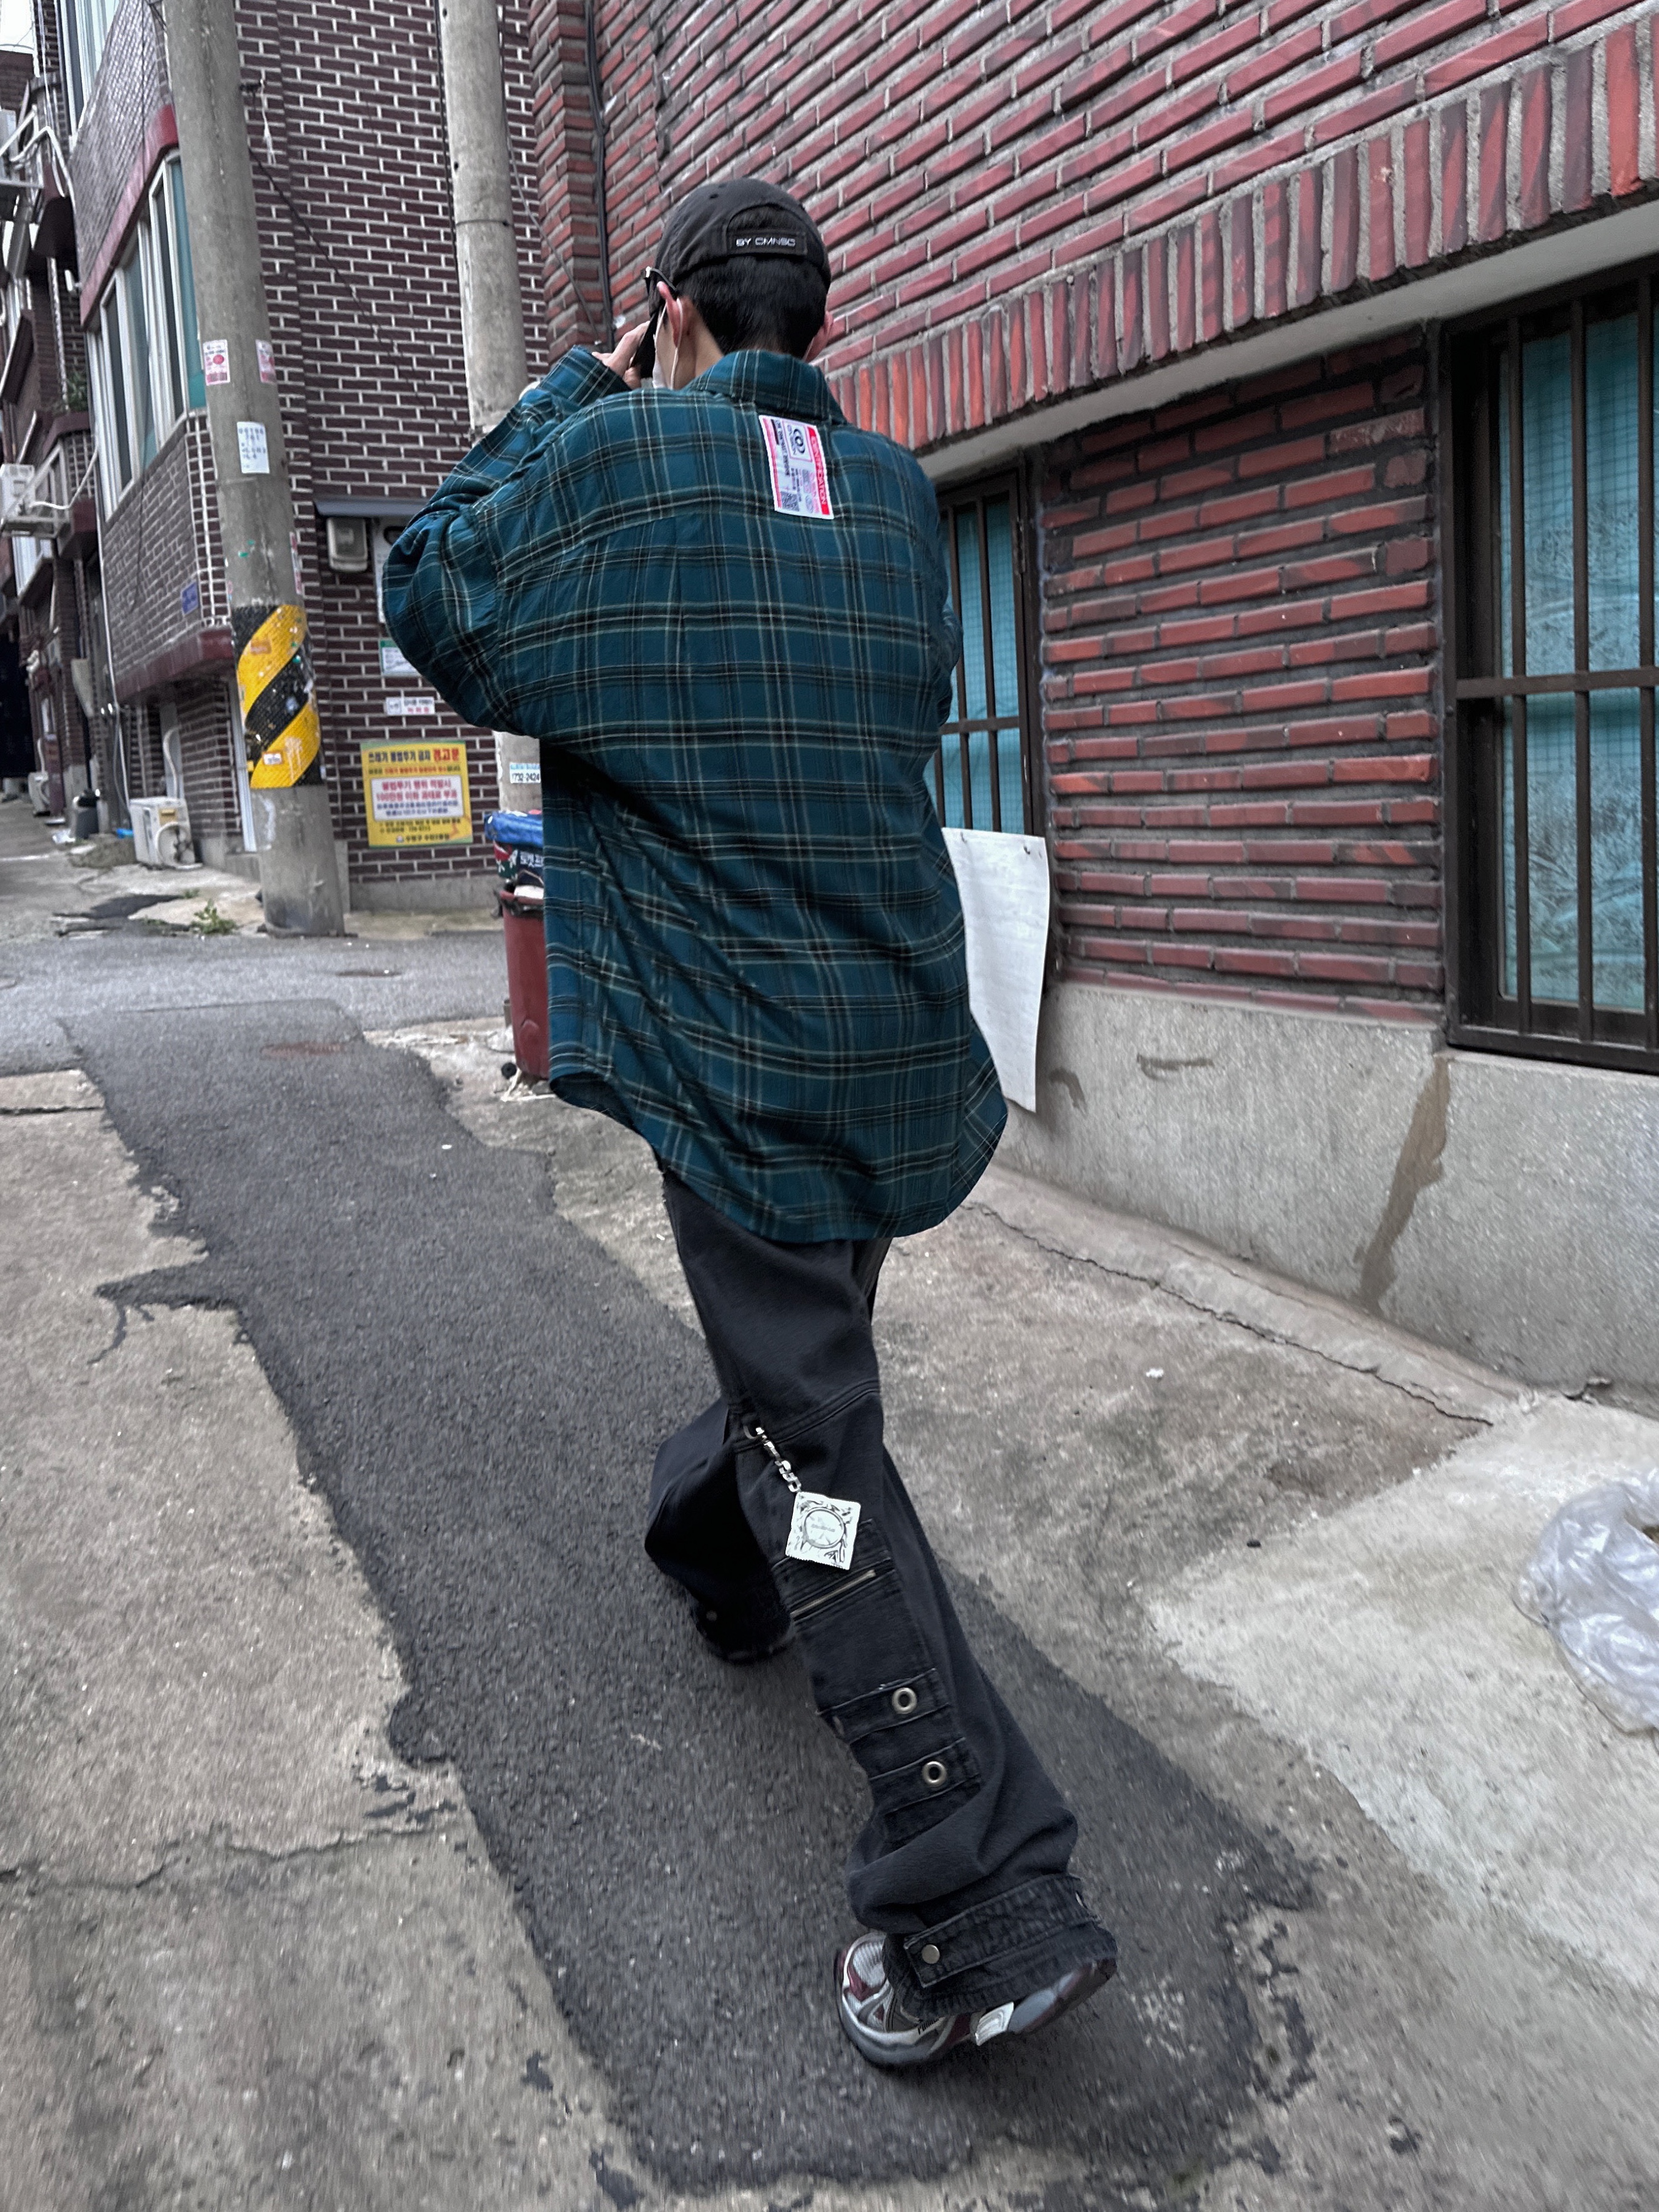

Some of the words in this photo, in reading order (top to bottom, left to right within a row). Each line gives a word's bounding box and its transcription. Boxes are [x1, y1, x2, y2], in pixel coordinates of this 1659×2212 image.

[736, 237, 752, 247] BY
[368, 751, 388, 763] 쓰레기
[391, 750, 416, 762] 불법투기
[433, 748, 459, 761] 경고문
